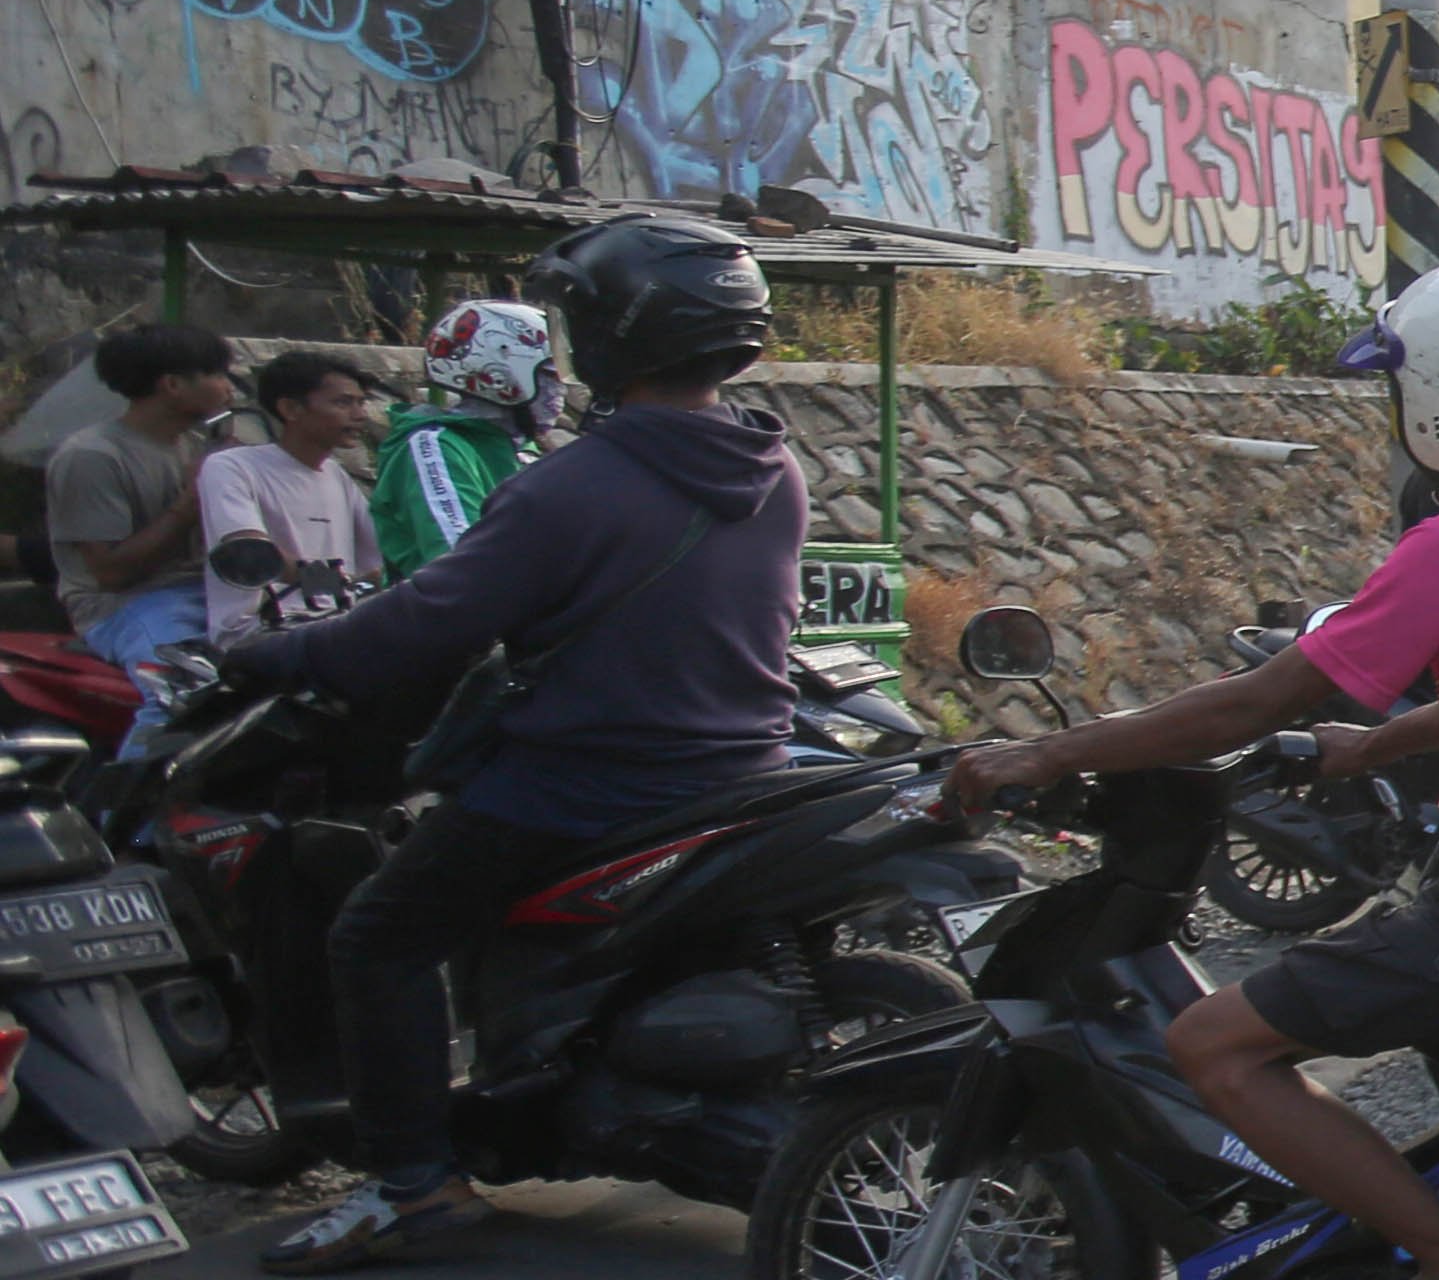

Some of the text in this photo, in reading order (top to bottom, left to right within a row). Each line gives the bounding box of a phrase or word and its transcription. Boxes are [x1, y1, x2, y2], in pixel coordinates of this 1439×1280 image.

[195, 823, 248, 844] HONDA
[84, 889, 155, 928] KDN
[41, 1172, 131, 1223] FEC
